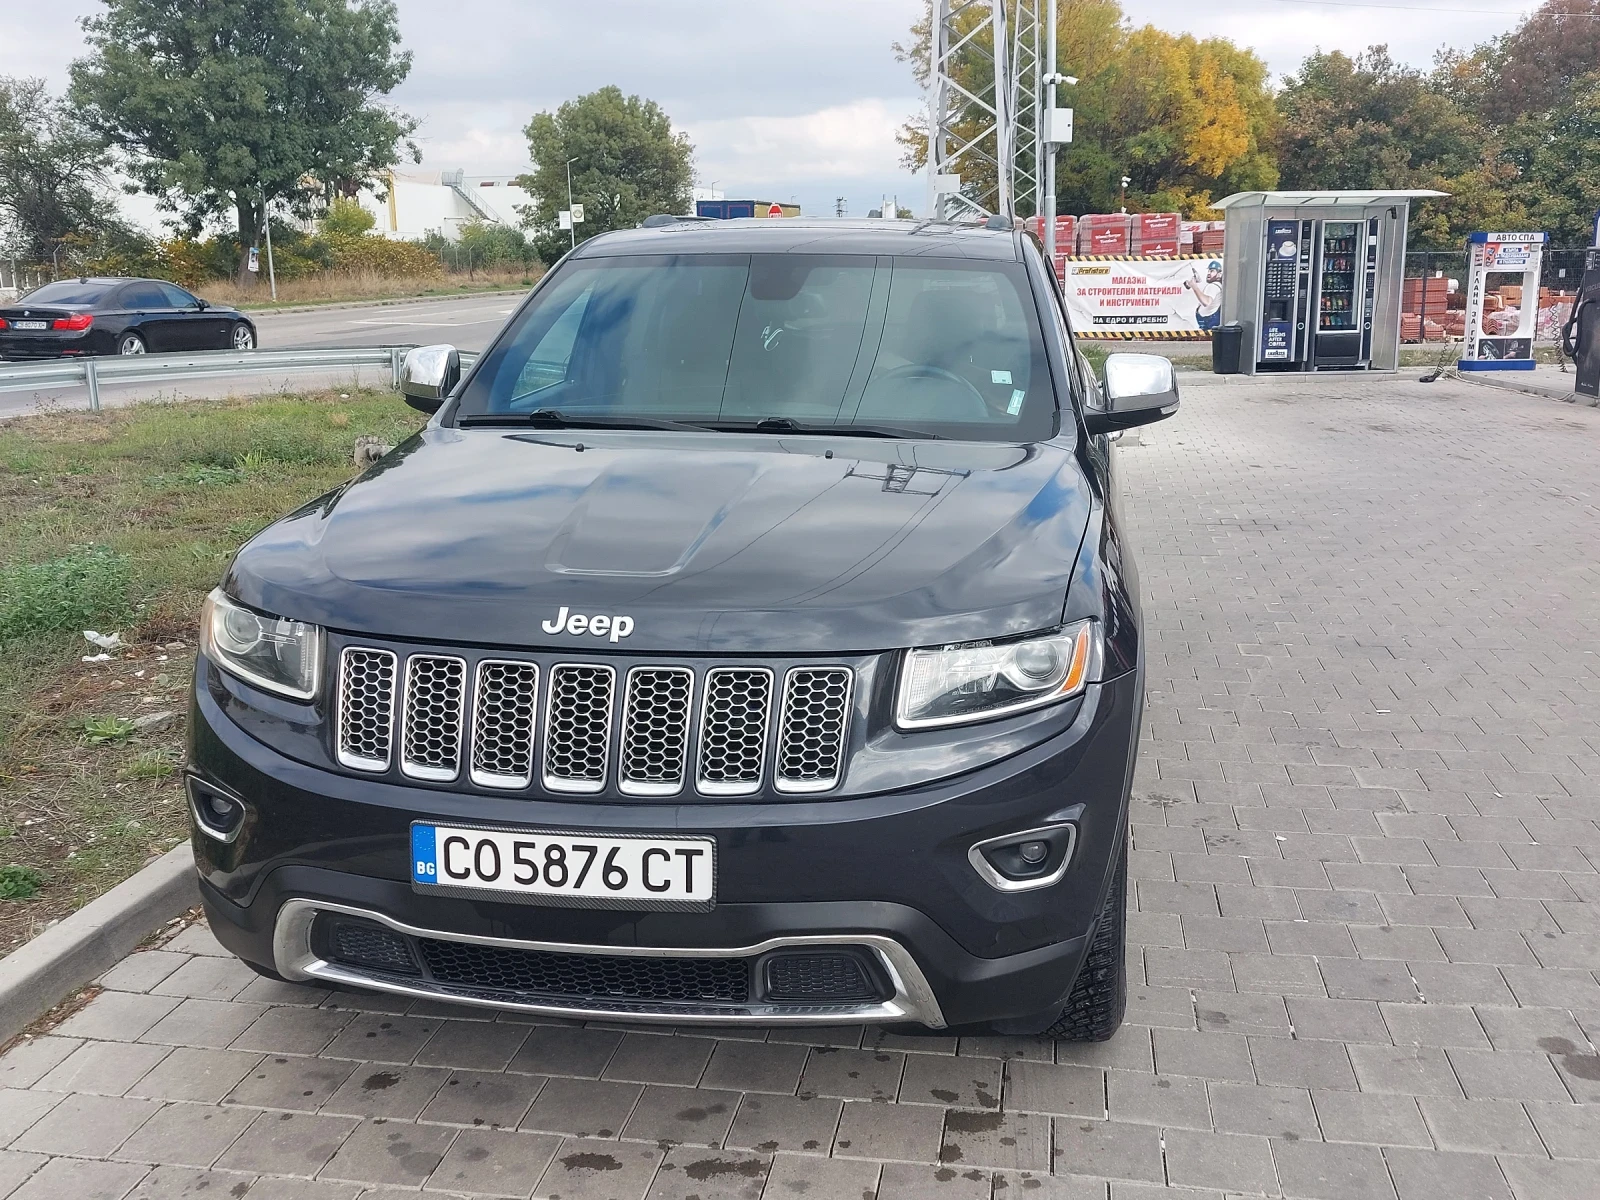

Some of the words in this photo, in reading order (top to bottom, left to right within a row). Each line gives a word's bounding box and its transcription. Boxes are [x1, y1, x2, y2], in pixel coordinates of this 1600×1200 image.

[1496, 233, 1517, 241] АВТО
[1519, 233, 1535, 241] СПА
[1111, 276, 1147, 285] МАГАЗИН
[1076, 287, 1087, 296] ЗА
[1088, 287, 1136, 296] СТРОИТЕЛНИ
[1137, 286, 1182, 296] МАТЕРИАЛИ
[1472, 270, 1480, 306] ГЛАНЦ
[1099, 299, 1105, 307] И
[1106, 298, 1160, 307] ИНСТРУМЕНТИ
[1136, 315, 1168, 324] ДРЕБНО
[1470, 312, 1477, 325] ЗА
[1468, 329, 1476, 357] ГУМИ
[541, 606, 635, 643] Jeep
[416, 860, 435, 875] BG
[443, 835, 501, 882] CO
[513, 840, 628, 891] 5876
[641, 847, 704, 893] CT
